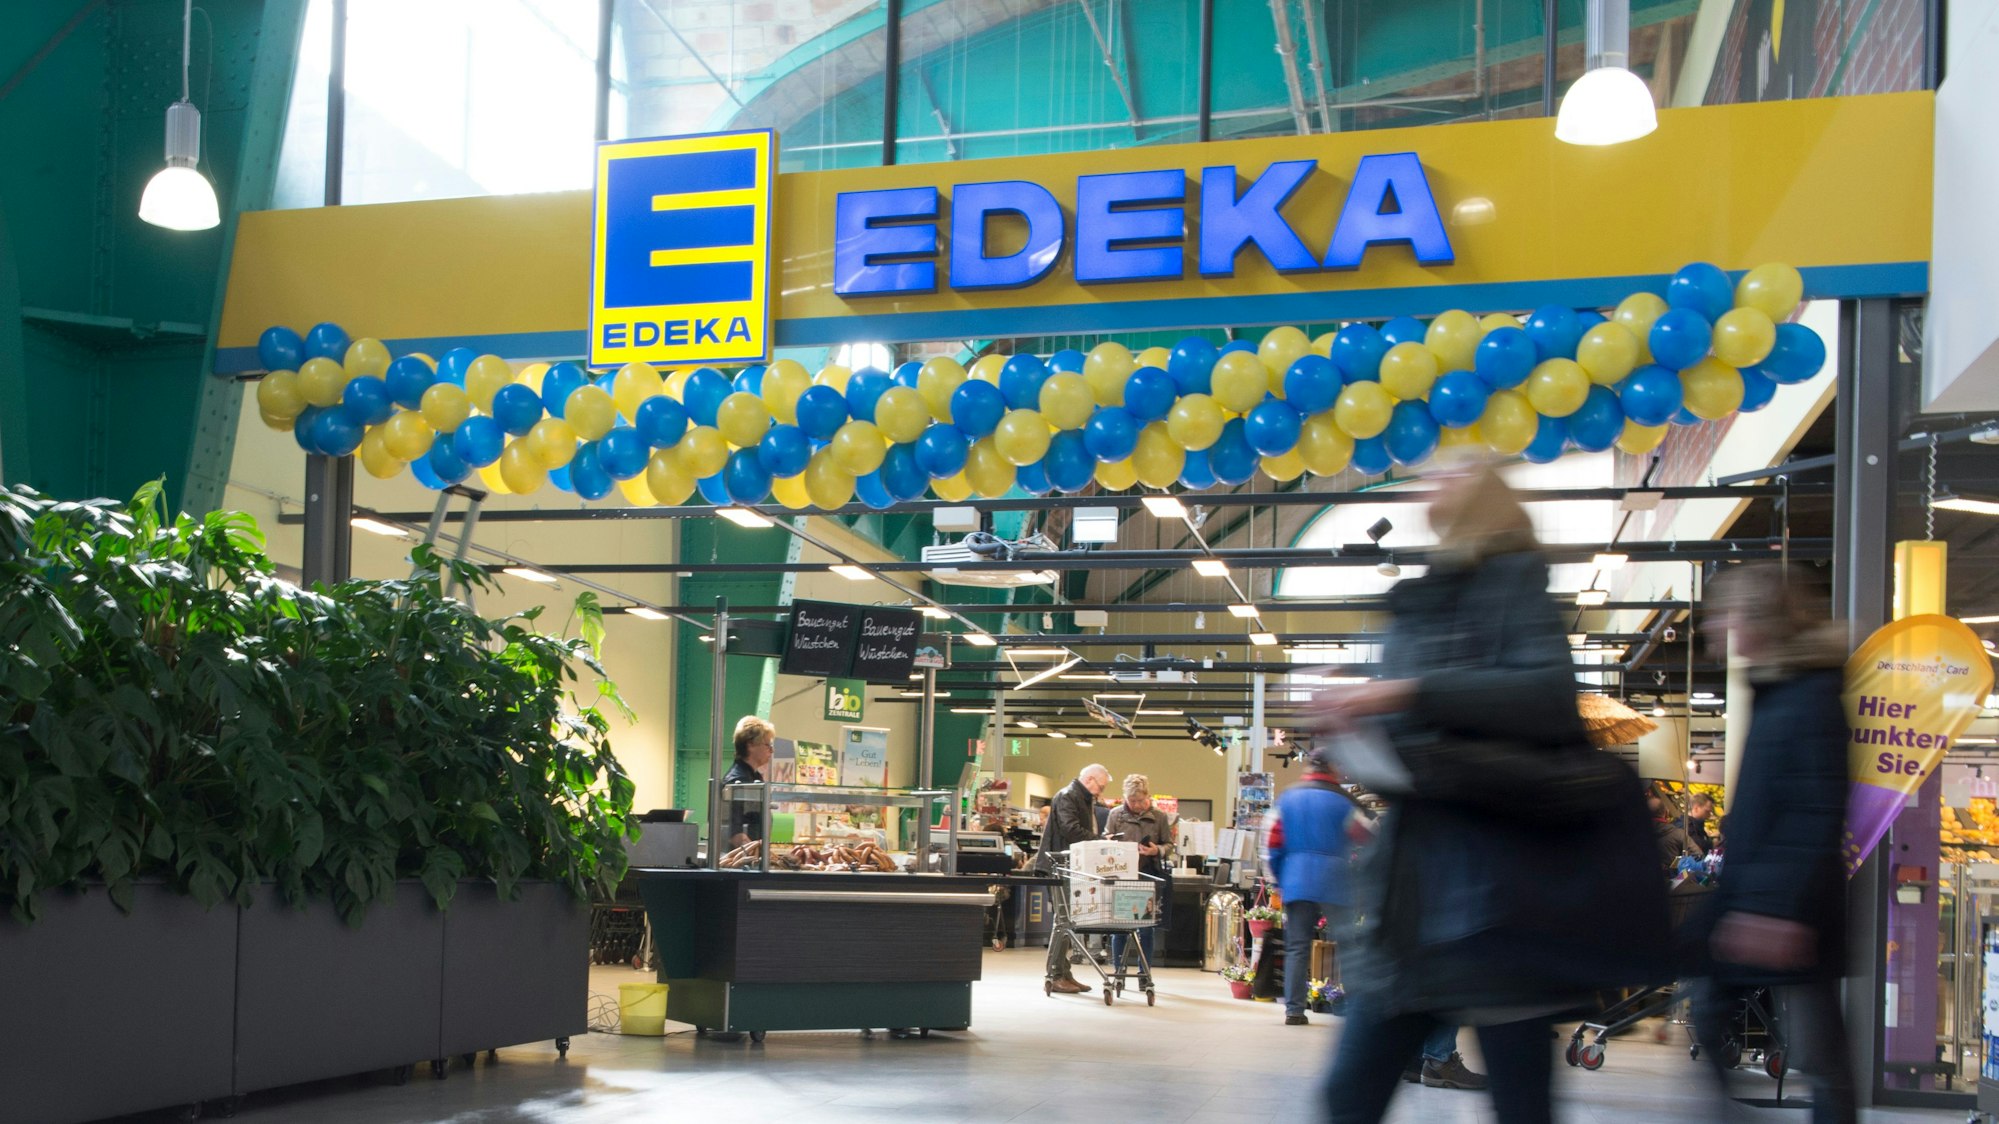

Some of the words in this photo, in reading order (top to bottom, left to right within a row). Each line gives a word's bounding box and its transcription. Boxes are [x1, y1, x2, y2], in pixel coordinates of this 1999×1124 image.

[604, 148, 757, 309] E
[835, 152, 1455, 297] EDEKA
[602, 316, 752, 349] EDEKA
[1877, 661, 1938, 674] Deutschland
[1946, 665, 1969, 675] Card
[829, 686, 861, 711] bio
[1858, 696, 1917, 719] Hier
[828, 710, 861, 719] ZENTRALE
[855, 758, 882, 768] Leben!
[861, 750, 877, 758] Gut
[1876, 752, 1926, 777] Sie.
[1096, 865, 1114, 873] Berliner
